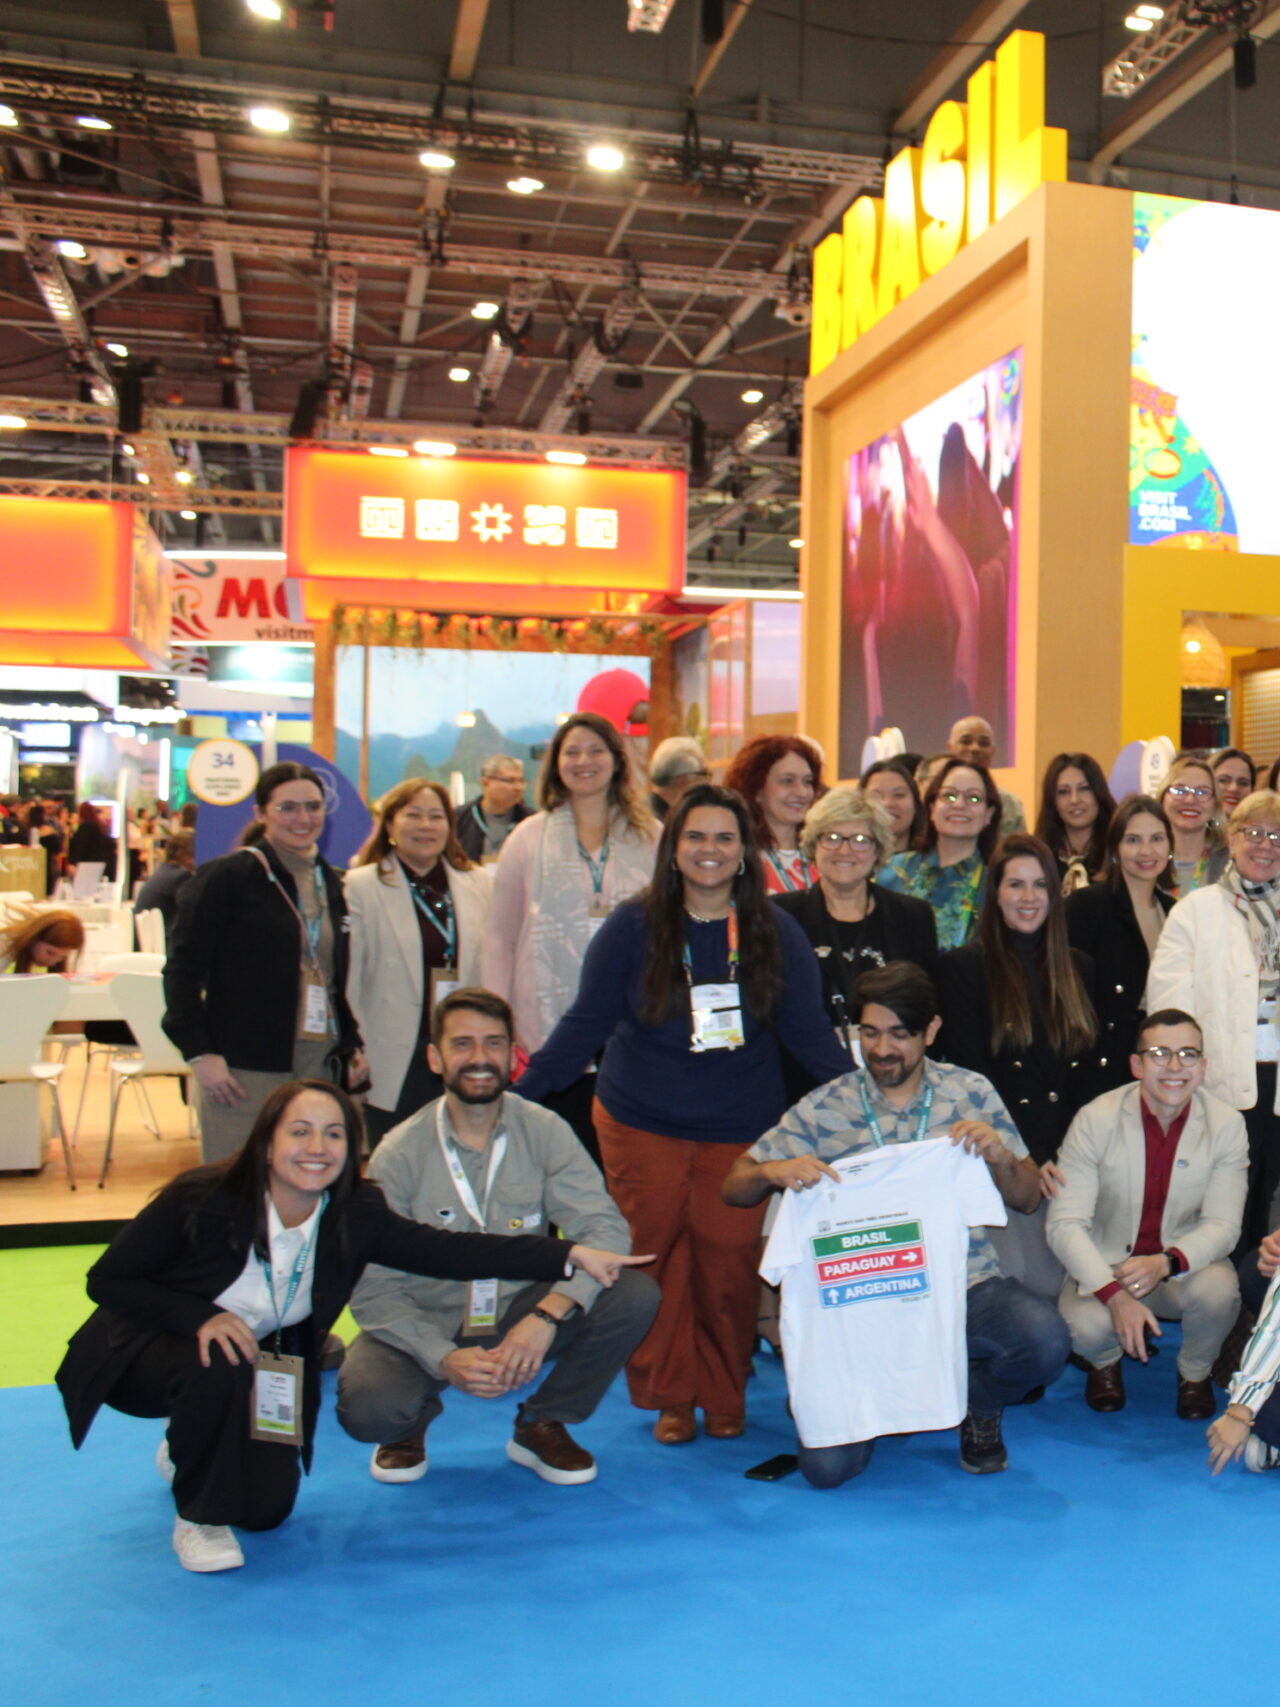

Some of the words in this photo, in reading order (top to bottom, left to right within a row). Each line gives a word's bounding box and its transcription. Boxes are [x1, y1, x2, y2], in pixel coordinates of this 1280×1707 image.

[811, 29, 1067, 377] BRASIL
[1139, 490, 1178, 505] VISIT
[1138, 503, 1193, 520] BRASIL
[211, 752, 235, 769] 34
[840, 1231, 892, 1249] BRASIL
[823, 1254, 896, 1278] PARAGUAY
[844, 1277, 922, 1300] ARGENTINA
